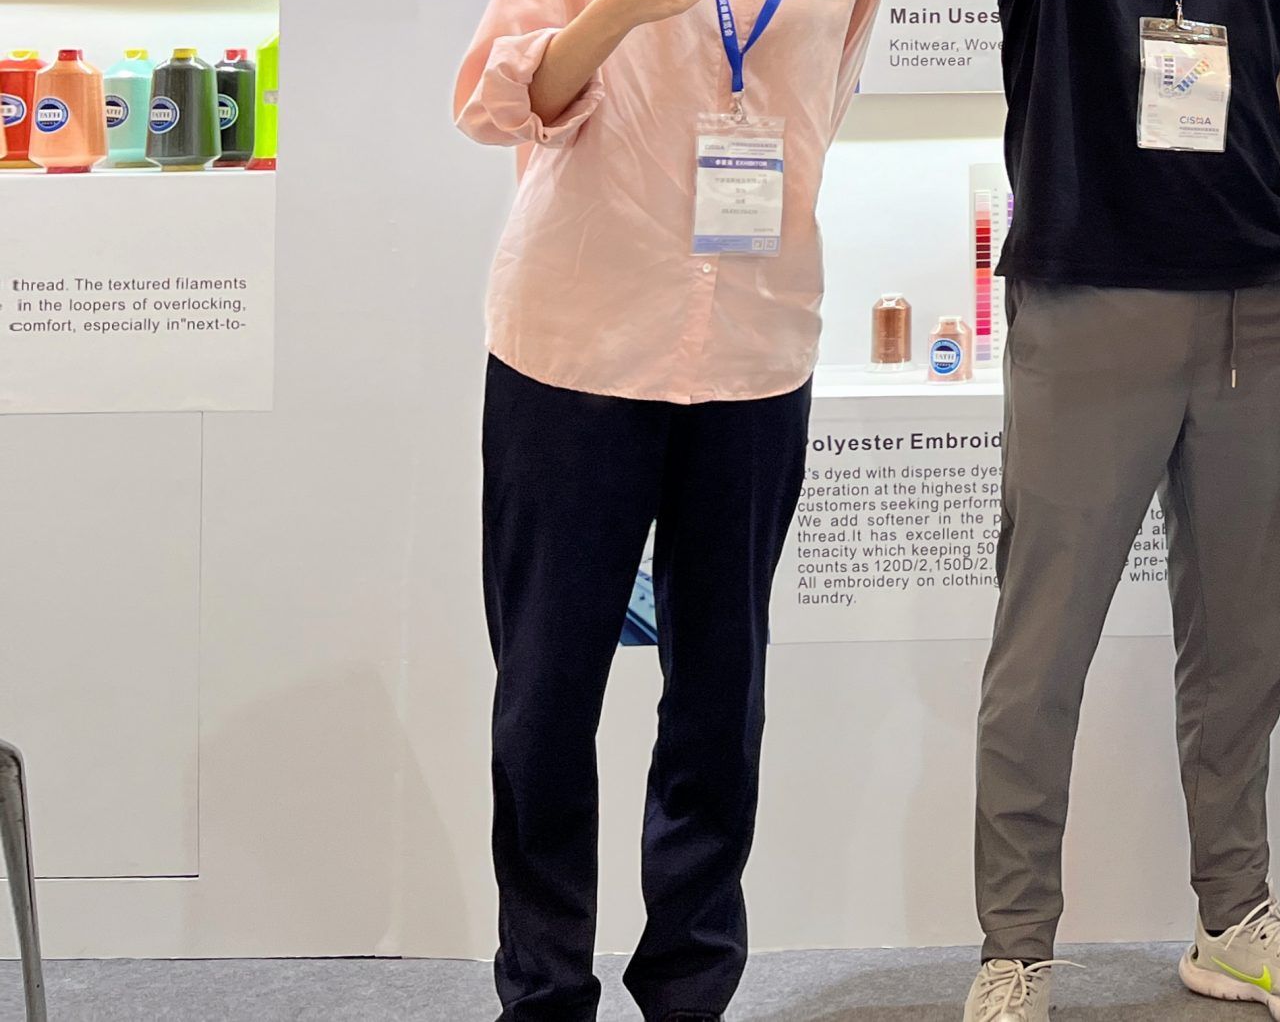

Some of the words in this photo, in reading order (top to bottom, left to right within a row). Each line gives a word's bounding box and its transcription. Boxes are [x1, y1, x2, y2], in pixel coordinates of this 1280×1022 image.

[889, 7, 941, 24] Main
[889, 37, 959, 53] Knitwear,
[889, 53, 972, 67] Underwear
[73, 277, 103, 291] The
[107, 277, 170, 291] textured
[175, 276, 247, 290] filaments
[17, 298, 32, 312] in
[38, 298, 62, 312] the
[68, 297, 126, 314] loopers
[131, 297, 148, 311] of
[152, 296, 246, 313] overlocking,
[8, 317, 76, 333] comfort,
[83, 317, 160, 334] especially
[823, 466, 861, 483] dyed
[865, 465, 896, 479] with
[900, 464, 966, 481] disperse
[873, 482, 889, 496] at
[892, 481, 917, 495] the
[920, 480, 977, 497] highest
[797, 499, 876, 512] customers
[879, 496, 939, 513] seeking
[796, 514, 822, 528] We
[829, 513, 858, 527] add
[866, 512, 930, 526] softener
[937, 511, 951, 525] in
[959, 511, 984, 525] the
[869, 528, 897, 542] has
[905, 526, 974, 541] excellent
[797, 544, 857, 561] tenacity
[861, 543, 906, 557] which
[911, 542, 973, 559] keeping
[797, 560, 848, 574] counts
[851, 562, 869, 573] as
[797, 575, 816, 589] All
[823, 574, 909, 591] embroidery
[915, 576, 935, 587] on
[797, 590, 857, 607] laundry.
